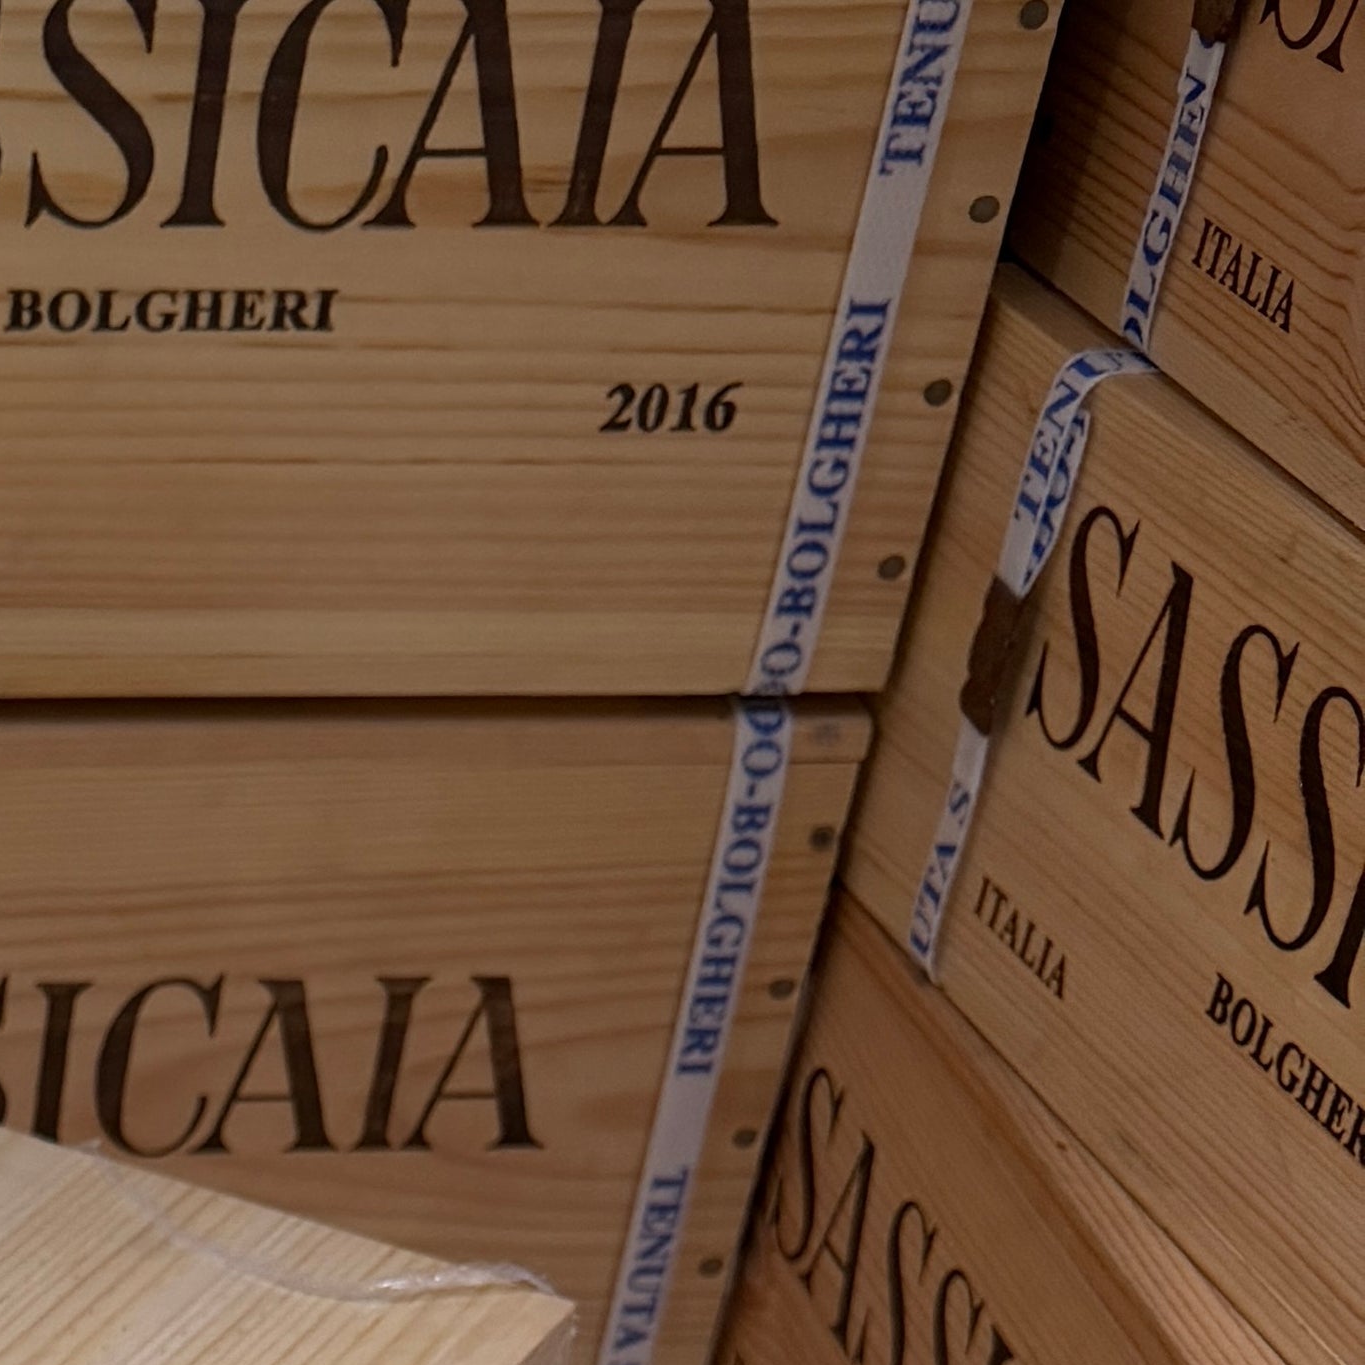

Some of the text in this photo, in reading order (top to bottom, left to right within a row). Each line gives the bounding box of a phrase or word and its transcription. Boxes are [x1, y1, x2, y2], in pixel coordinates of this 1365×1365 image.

[4, 288, 339, 334] BOLGHERI
[1191, 217, 1295, 333] ITALIA
[600, 382, 744, 434] 2016
[974, 875, 1067, 1001] ITALIA
[612, 1167, 690, 1353] TENUTA
